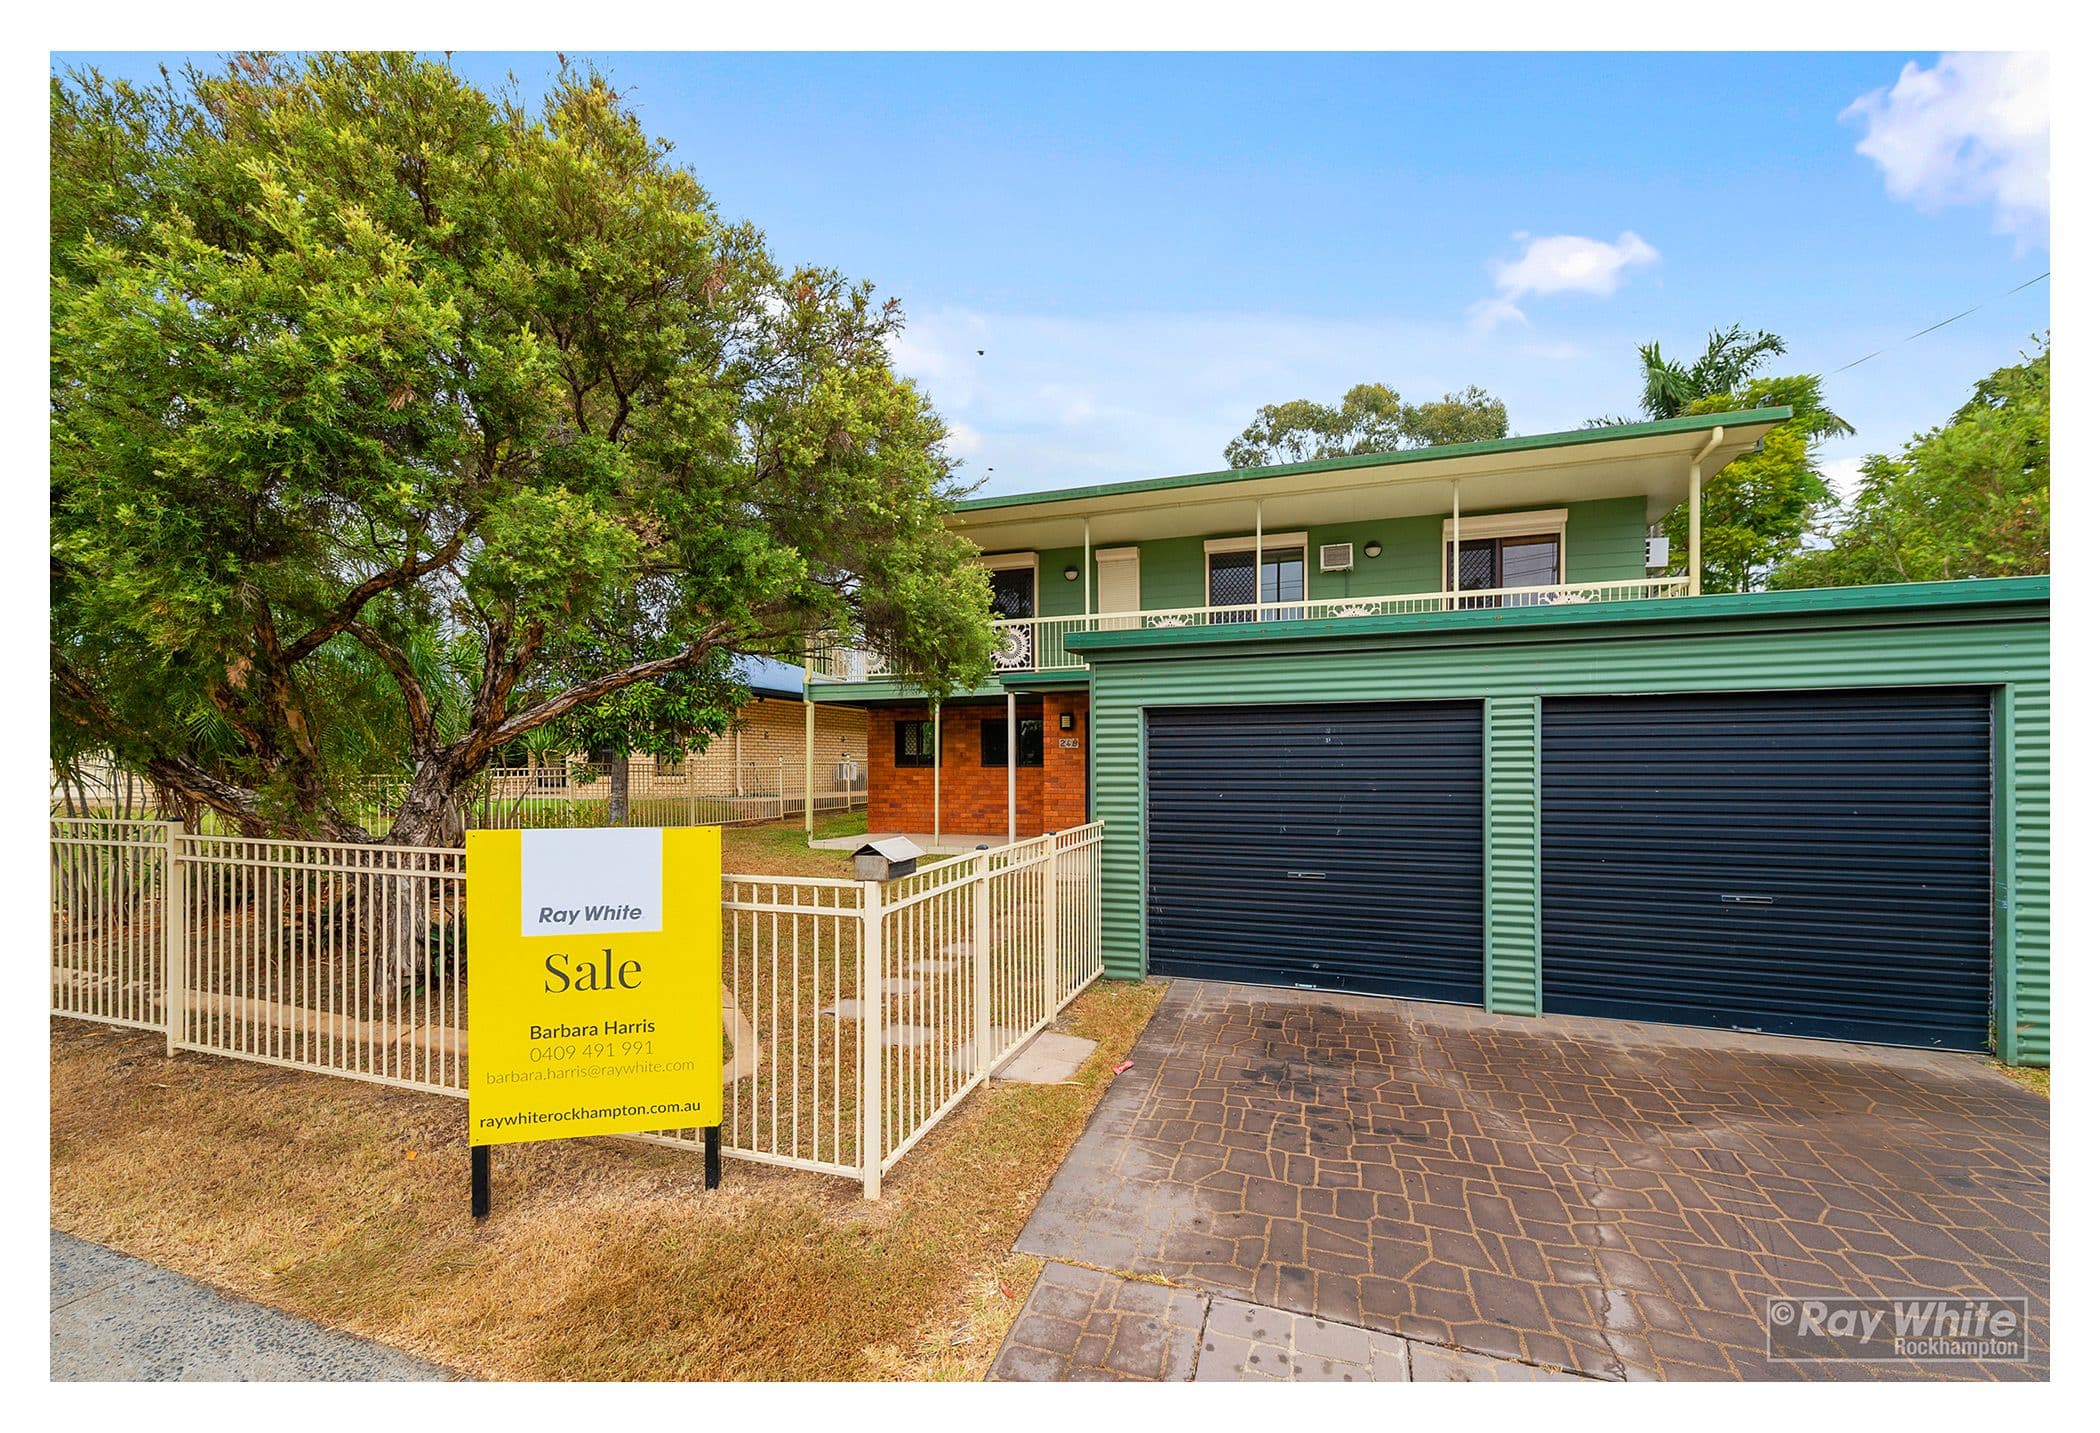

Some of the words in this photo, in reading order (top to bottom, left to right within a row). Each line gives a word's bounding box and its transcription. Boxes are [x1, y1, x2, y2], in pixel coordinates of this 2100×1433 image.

[538, 907, 581, 925] Ray
[585, 904, 642, 921] White
[544, 948, 642, 993] Sale
[530, 1023, 598, 1040] Barbara
[604, 1019, 655, 1035] Harris
[530, 1046, 576, 1062] 0409
[582, 1043, 615, 1059] 491
[622, 1040, 654, 1057] 991
[486, 1059, 695, 1085] barbara.harris@raywhite.com
[480, 1101, 701, 1129] raywhiterockhampton.com.au
